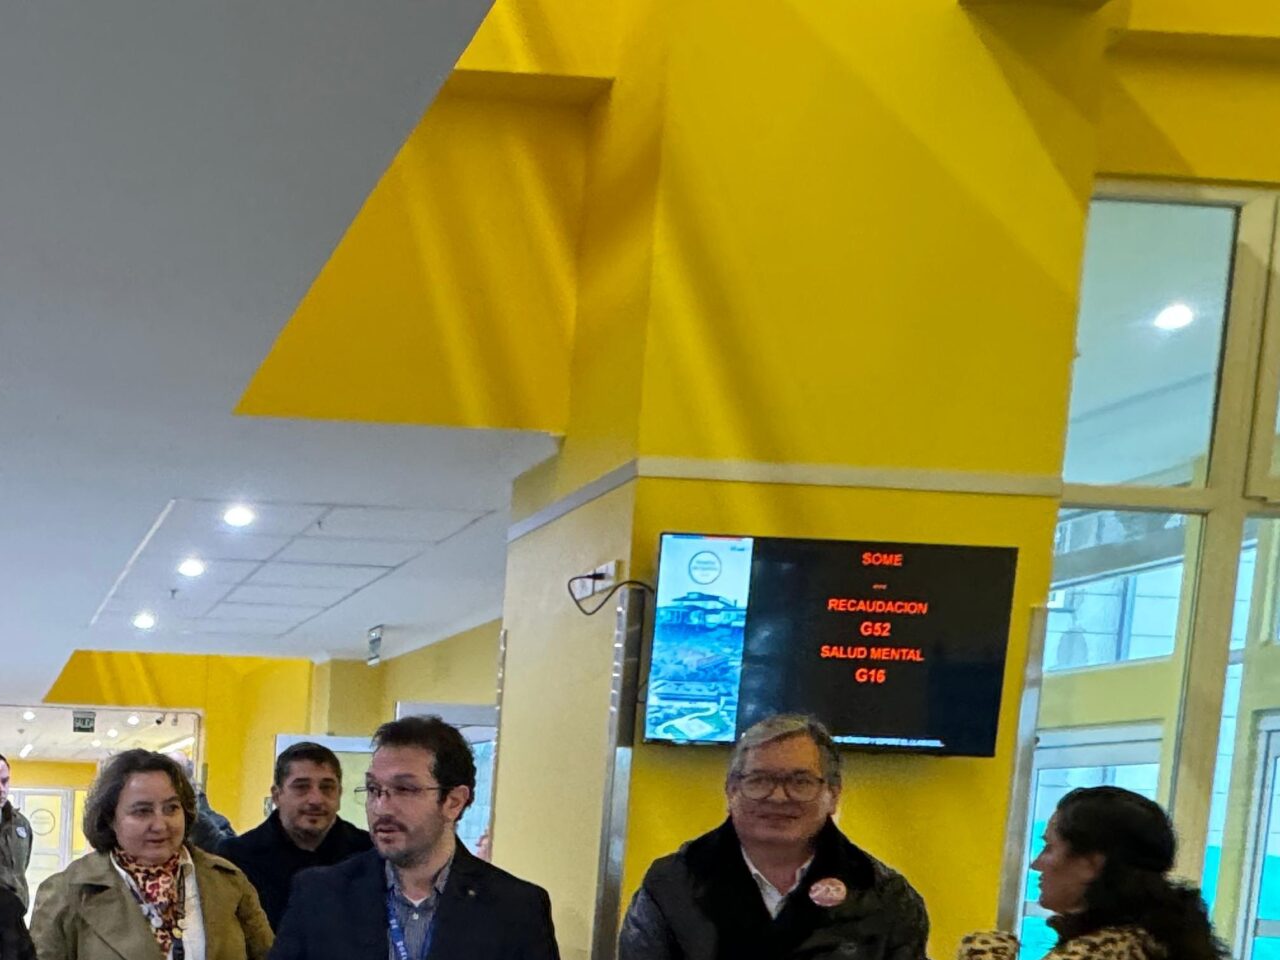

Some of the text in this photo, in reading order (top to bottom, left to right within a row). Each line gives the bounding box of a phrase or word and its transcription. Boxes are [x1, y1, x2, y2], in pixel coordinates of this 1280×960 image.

[862, 552, 904, 567] SOME
[827, 598, 929, 615] RECAUDACION
[860, 621, 892, 637] G52
[820, 645, 925, 662] SALUD MENTAL
[855, 668, 887, 684] G16
